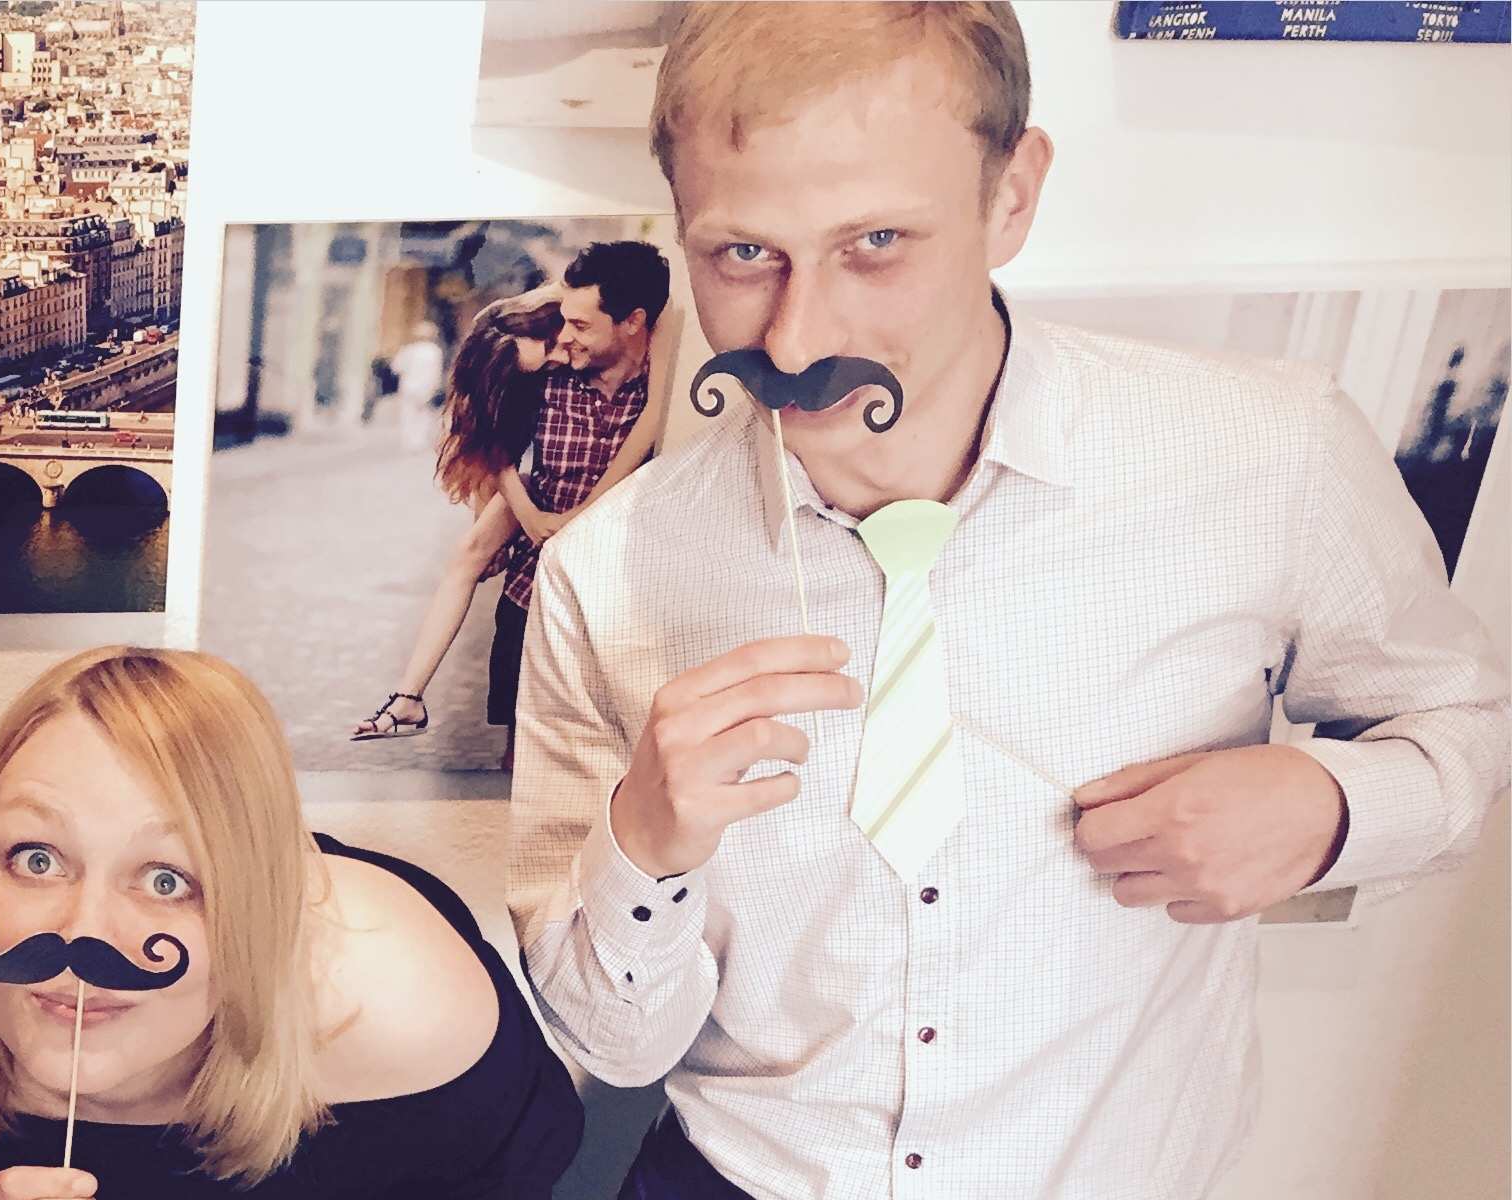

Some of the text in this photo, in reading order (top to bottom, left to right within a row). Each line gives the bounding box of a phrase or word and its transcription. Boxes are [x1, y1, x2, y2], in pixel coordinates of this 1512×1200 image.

[1280, 7, 1336, 22] MANILA
[1422, 12, 1459, 28] TOKYO
[1179, 26, 1217, 40] PENH
[1282, 24, 1328, 38] PERTH
[1416, 28, 1455, 42] SEOUL
